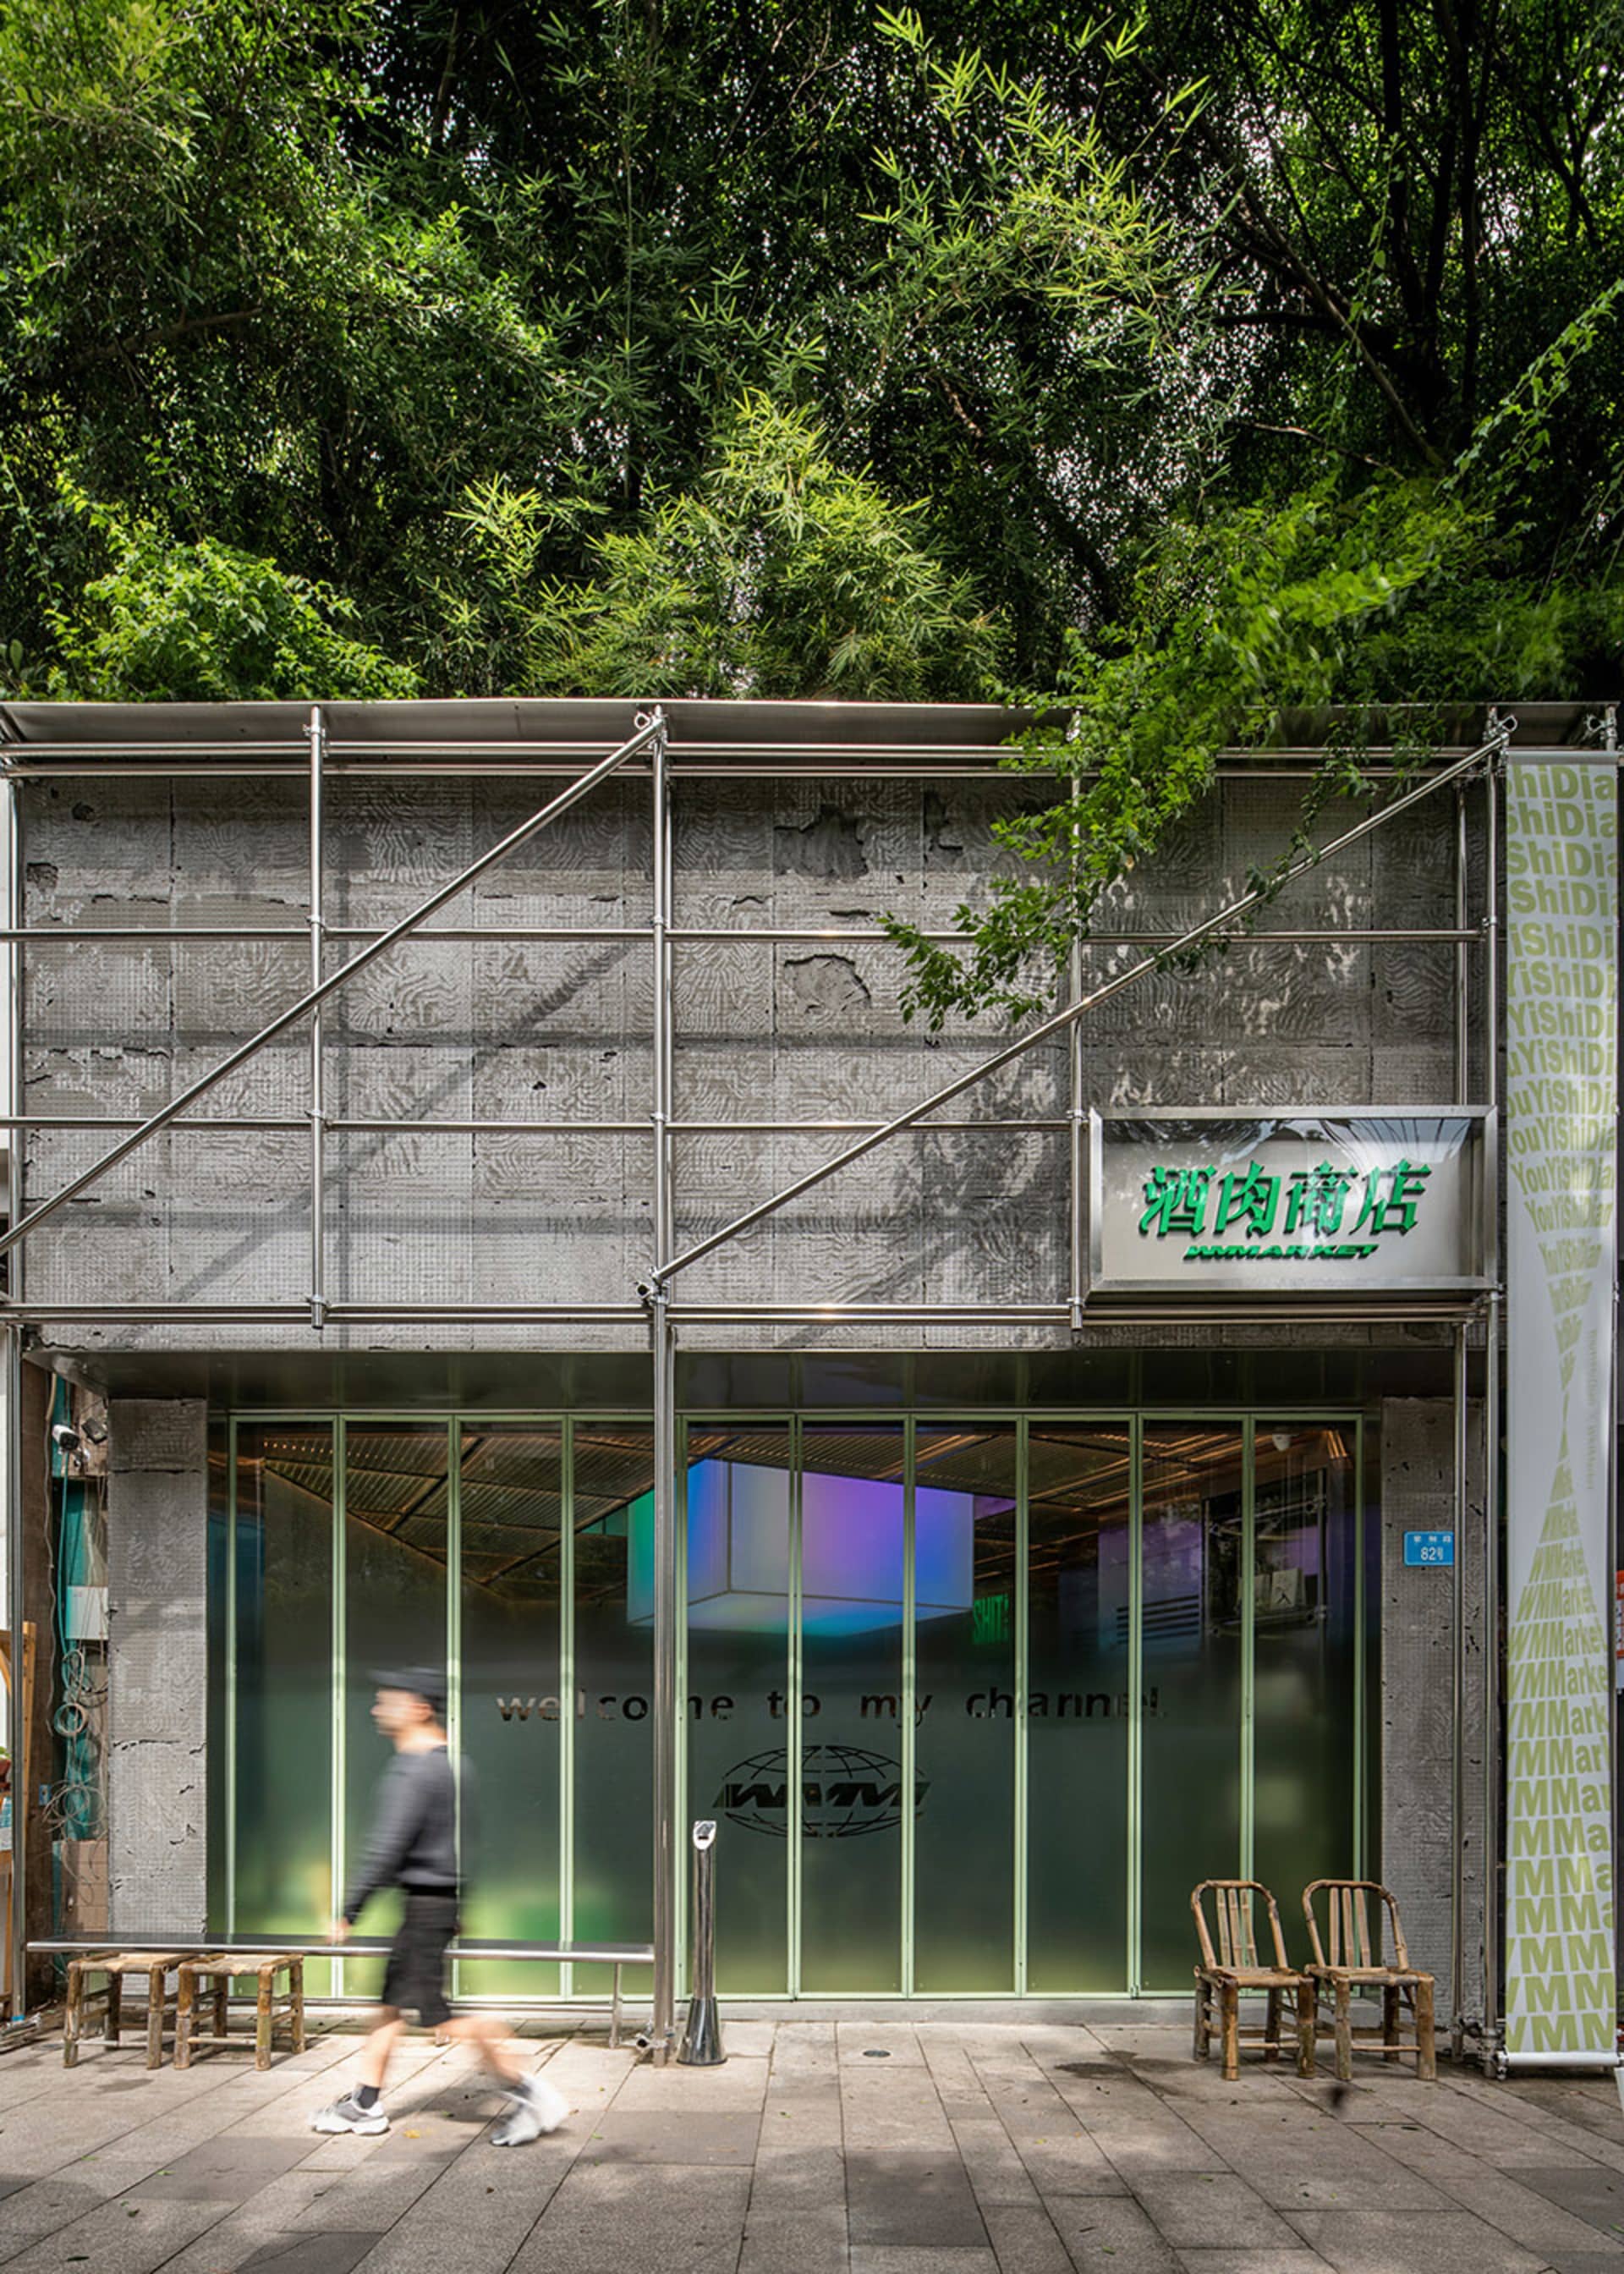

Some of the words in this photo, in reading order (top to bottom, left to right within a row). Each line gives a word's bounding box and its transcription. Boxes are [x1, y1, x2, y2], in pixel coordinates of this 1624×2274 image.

[1138, 1159, 1431, 1238] 酒肉商店
[767, 1691, 821, 1721] to
[860, 1693, 933, 1728] my
